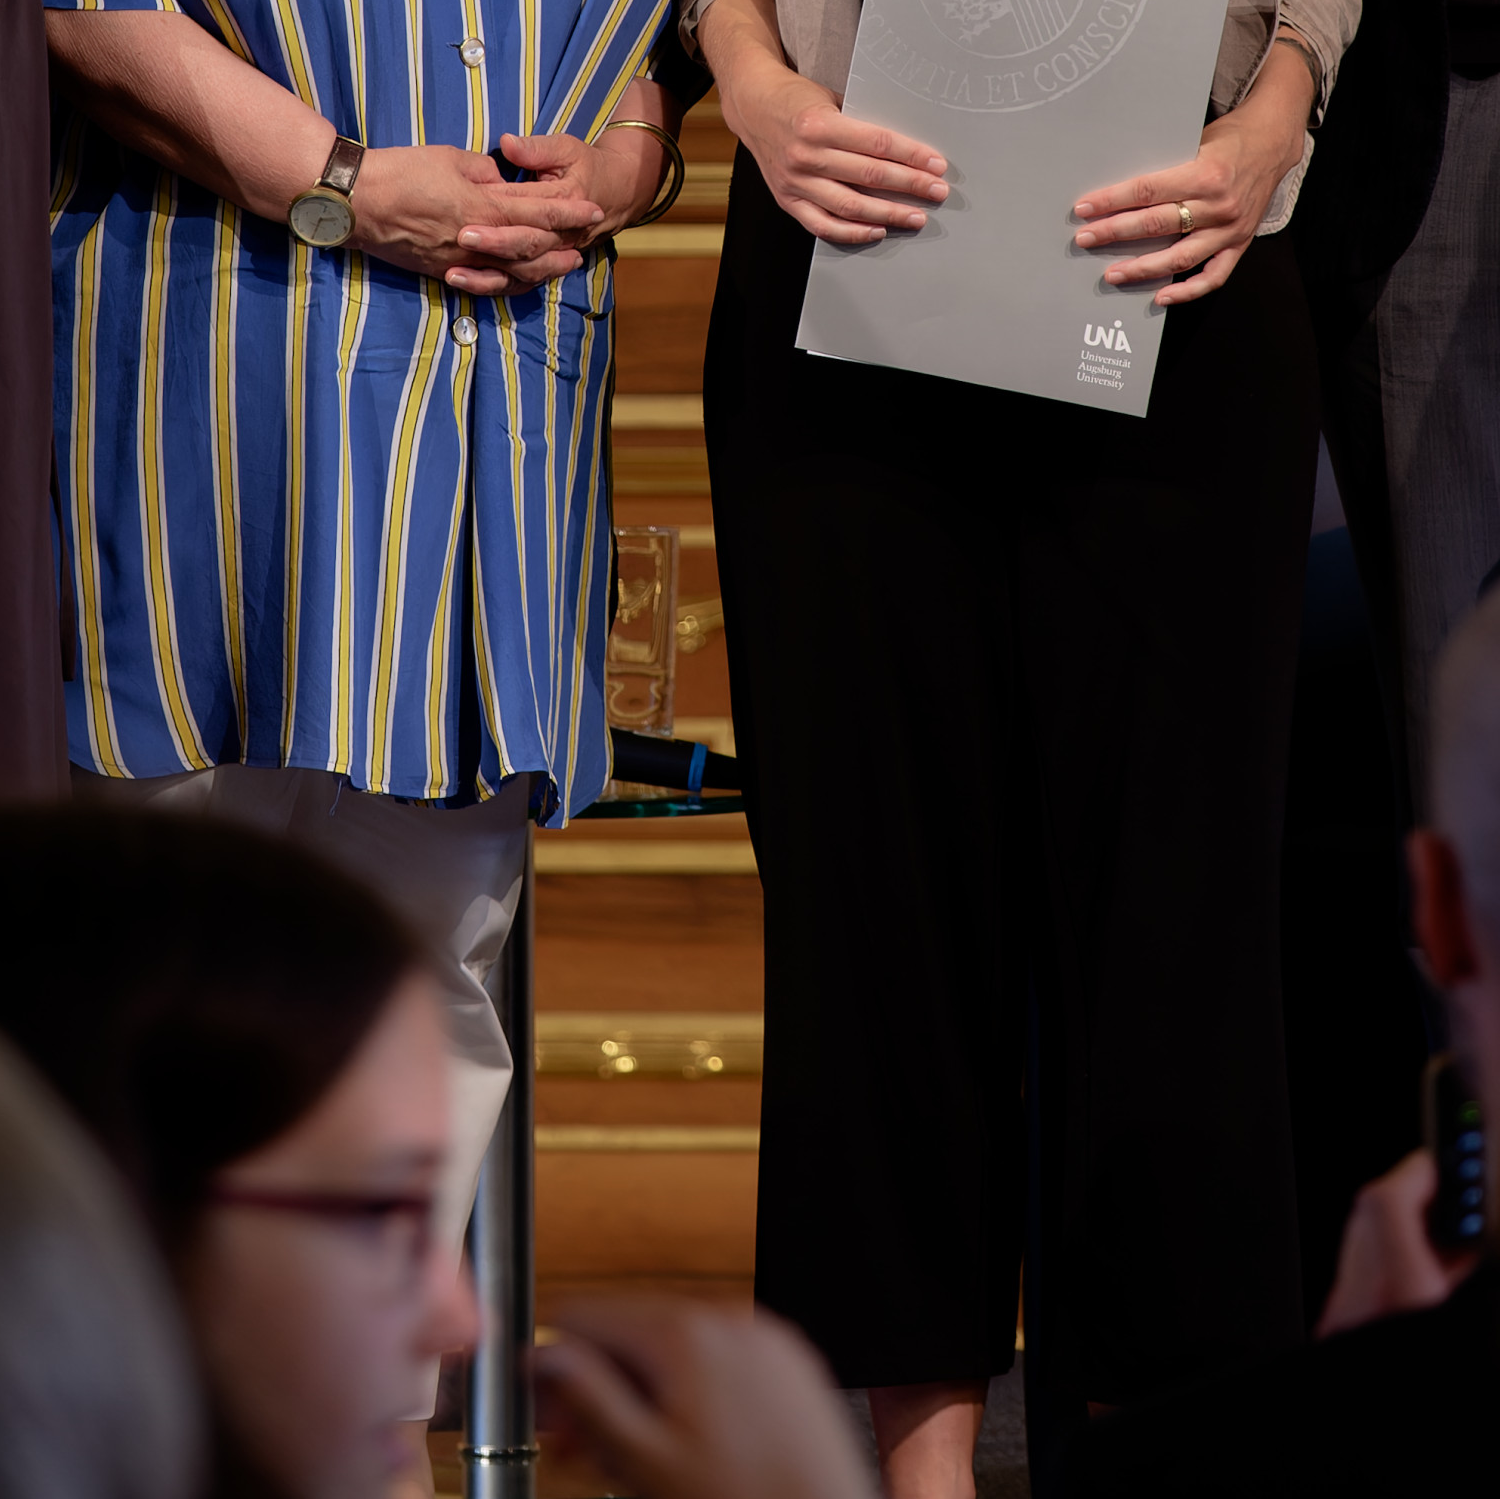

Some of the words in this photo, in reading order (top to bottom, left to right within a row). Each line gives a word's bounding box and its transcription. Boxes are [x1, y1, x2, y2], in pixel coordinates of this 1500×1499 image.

[987, 71, 1025, 106] ET
[1080, 350, 1131, 369] Universität
[1078, 361, 1122, 379] Augsburg
[1076, 371, 1125, 391] University
